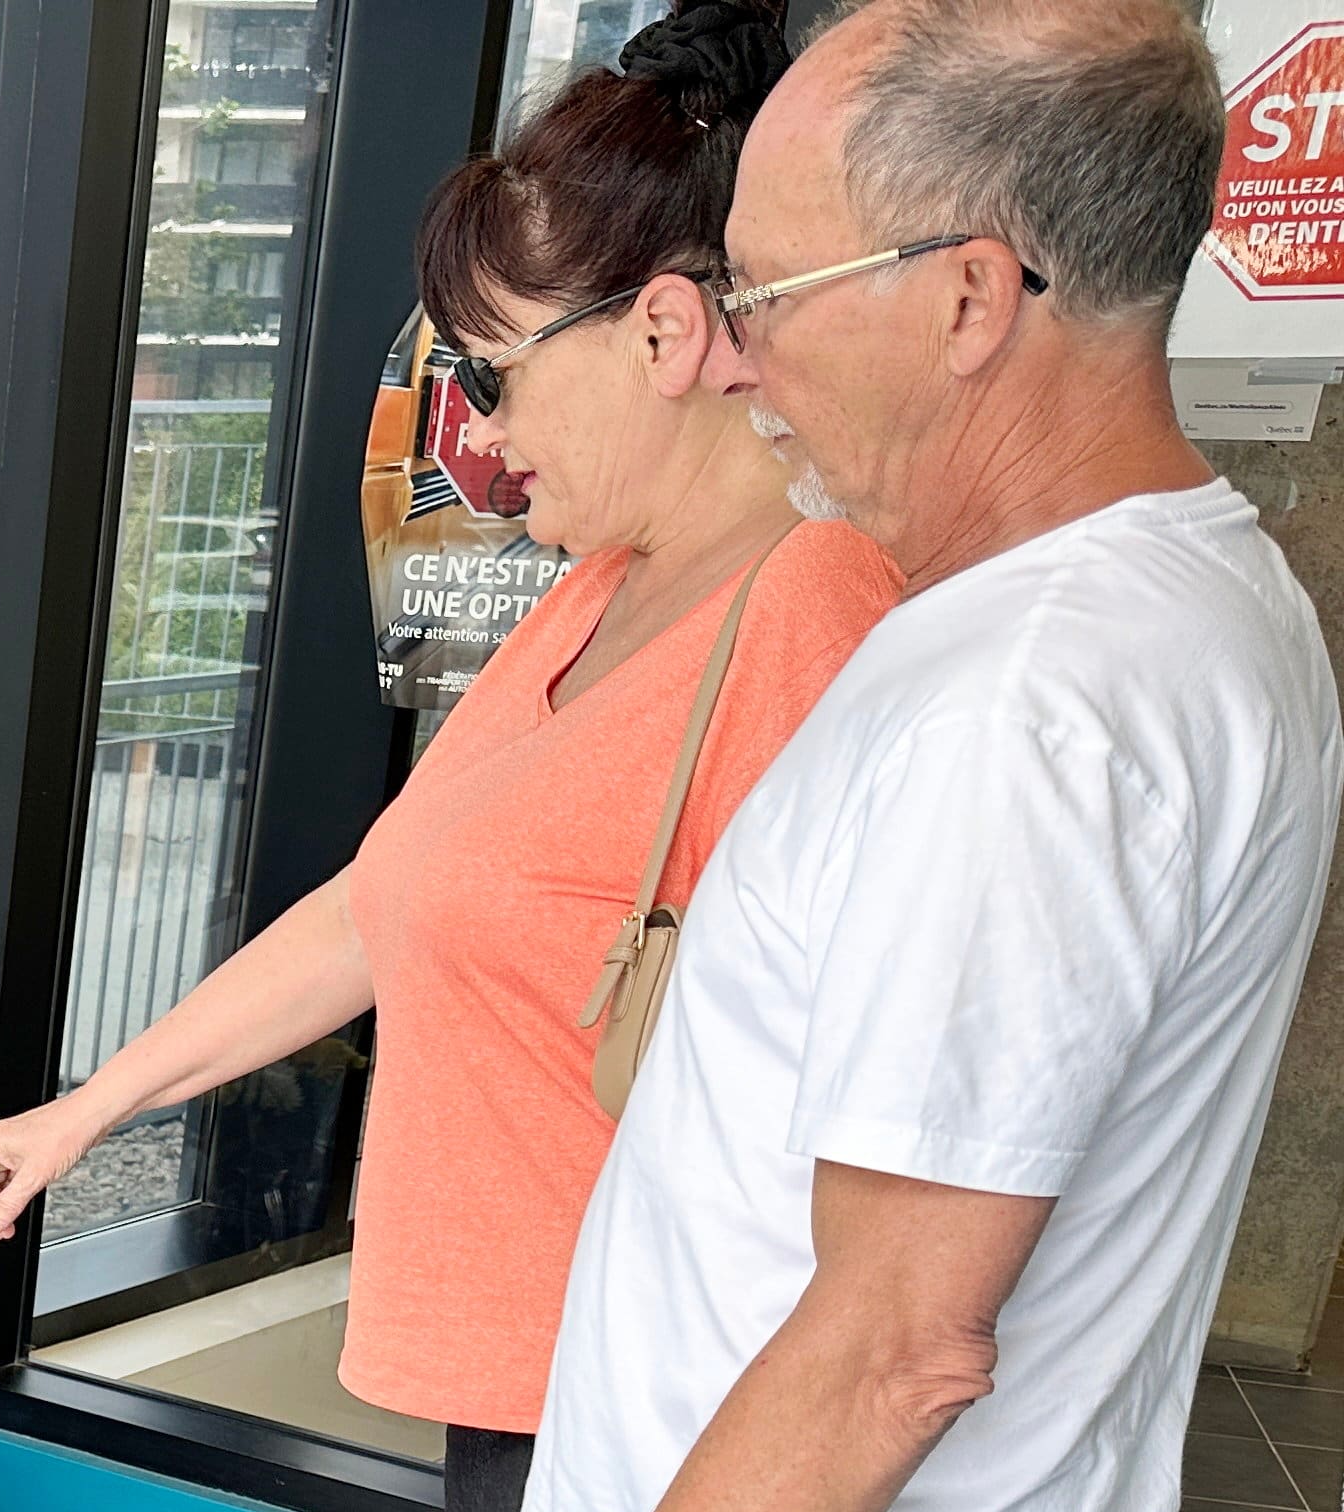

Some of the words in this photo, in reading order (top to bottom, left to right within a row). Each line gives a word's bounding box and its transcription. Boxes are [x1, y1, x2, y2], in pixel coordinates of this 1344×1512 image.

[1242, 92, 1344, 163] ST
[1227, 177, 1327, 197] VEUILLEZ
[1329, 178, 1344, 193] A
[1222, 200, 1286, 219] QU'ON
[1291, 199, 1344, 215] VOUS
[404, 554, 440, 582] CE
[445, 555, 531, 585] N'EST
[536, 560, 572, 587] PA
[402, 589, 463, 618] UNE
[468, 592, 541, 622] OPTI
[388, 622, 422, 639] Votre
[424, 625, 489, 643] attention
[492, 630, 508, 644] sa
